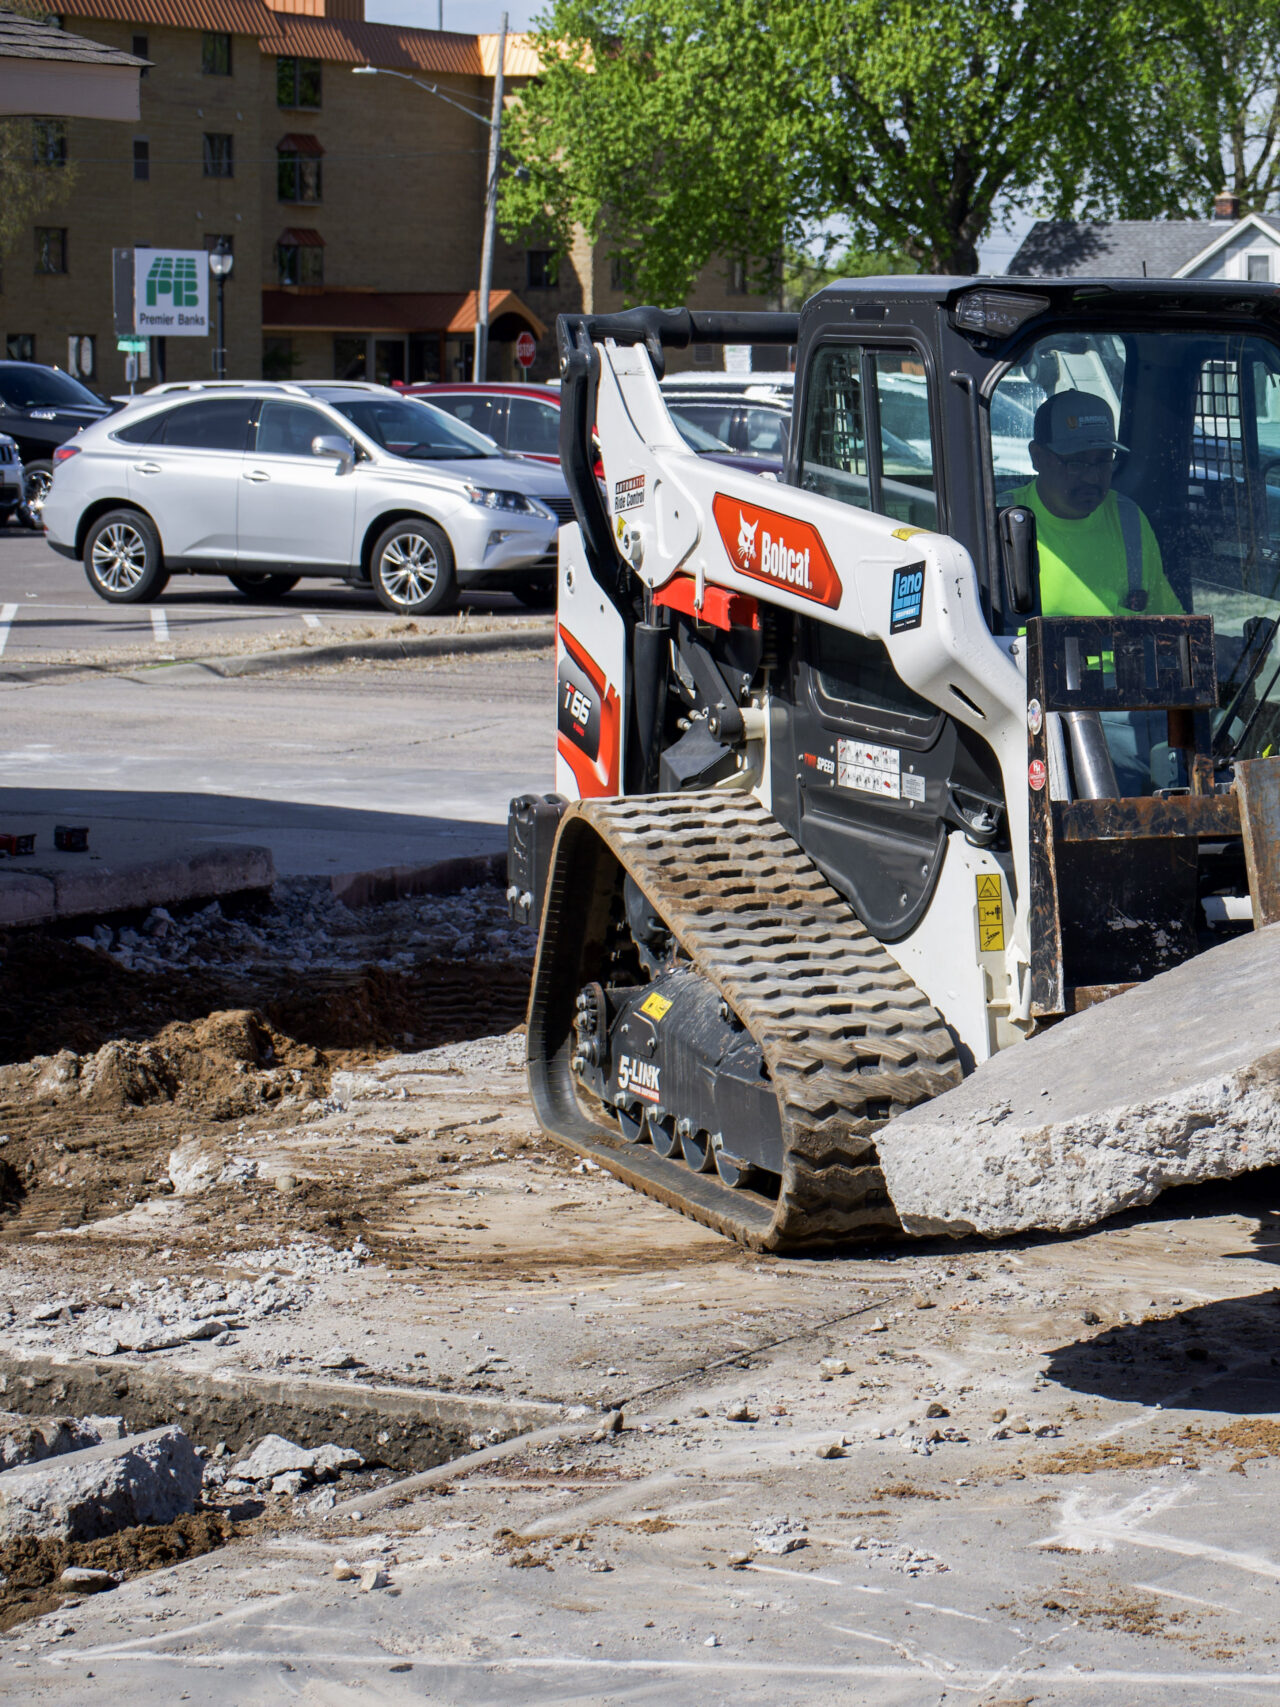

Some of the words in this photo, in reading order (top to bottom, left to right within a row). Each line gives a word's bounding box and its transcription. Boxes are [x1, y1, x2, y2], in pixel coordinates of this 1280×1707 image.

[140, 313, 174, 325] Premier
[178, 314, 205, 326] Banks
[517, 343, 535, 357] STOP
[615, 495, 626, 510] Ride
[627, 489, 644, 506] Control
[761, 530, 811, 589] Bobcat
[817, 757, 835, 774] SPEED
[618, 1055, 660, 1090] 5-LINK
